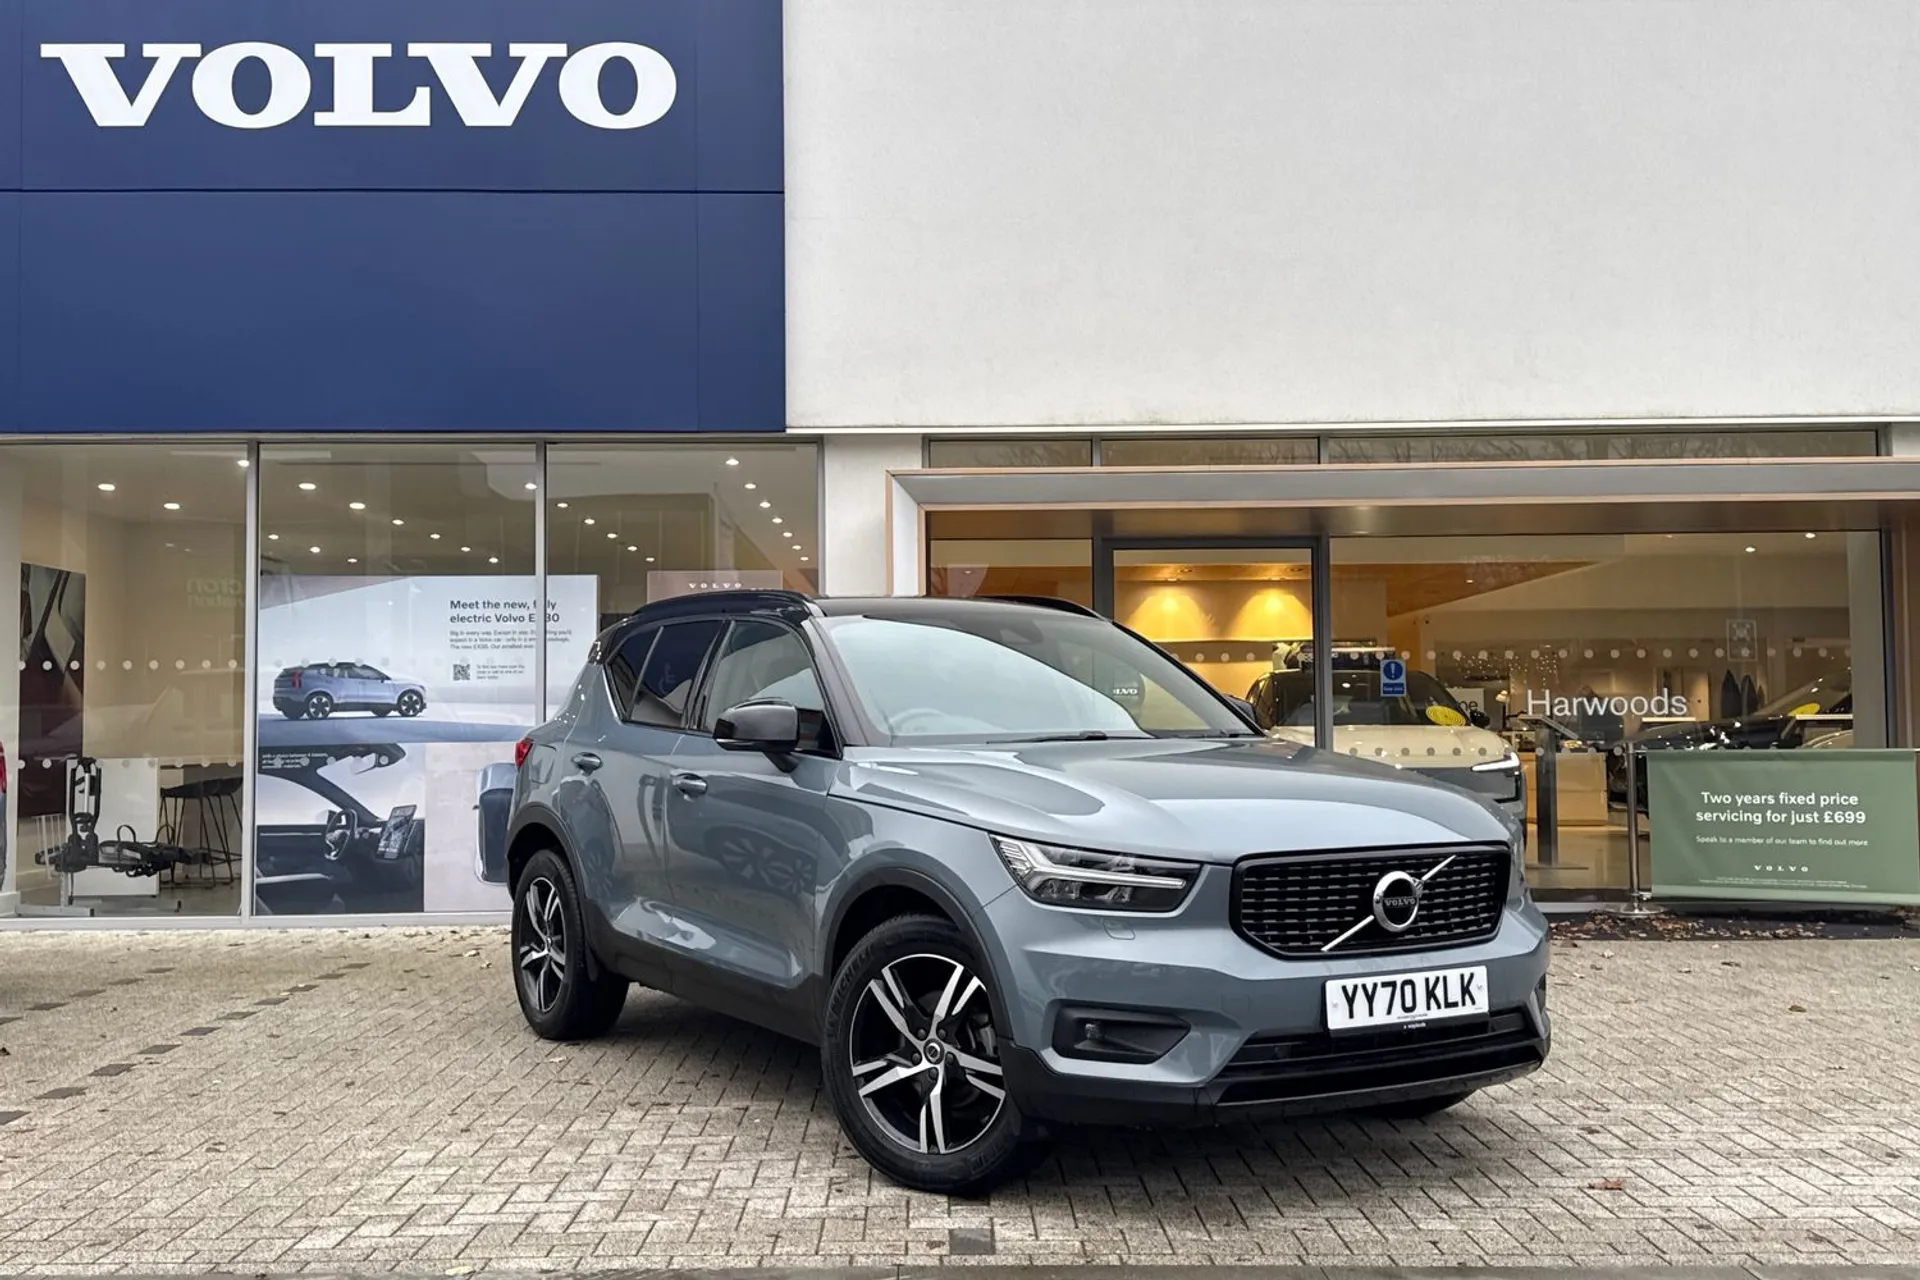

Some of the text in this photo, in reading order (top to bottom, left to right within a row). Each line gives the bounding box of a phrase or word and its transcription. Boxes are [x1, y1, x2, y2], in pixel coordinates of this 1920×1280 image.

[40, 41, 678, 130] VOLVO
[450, 600, 556, 611] Meet the new, fly
[450, 613, 560, 623] electric Volvo E30
[1527, 688, 1688, 717] Harwoods
[1702, 792, 1859, 808] Two years fixed price
[1696, 810, 1866, 825] servicing for just £699
[1696, 836, 1718, 844] Speak
[1384, 898, 1416, 906] VOLVO
[1342, 972, 1476, 1020] YY70 KLK
